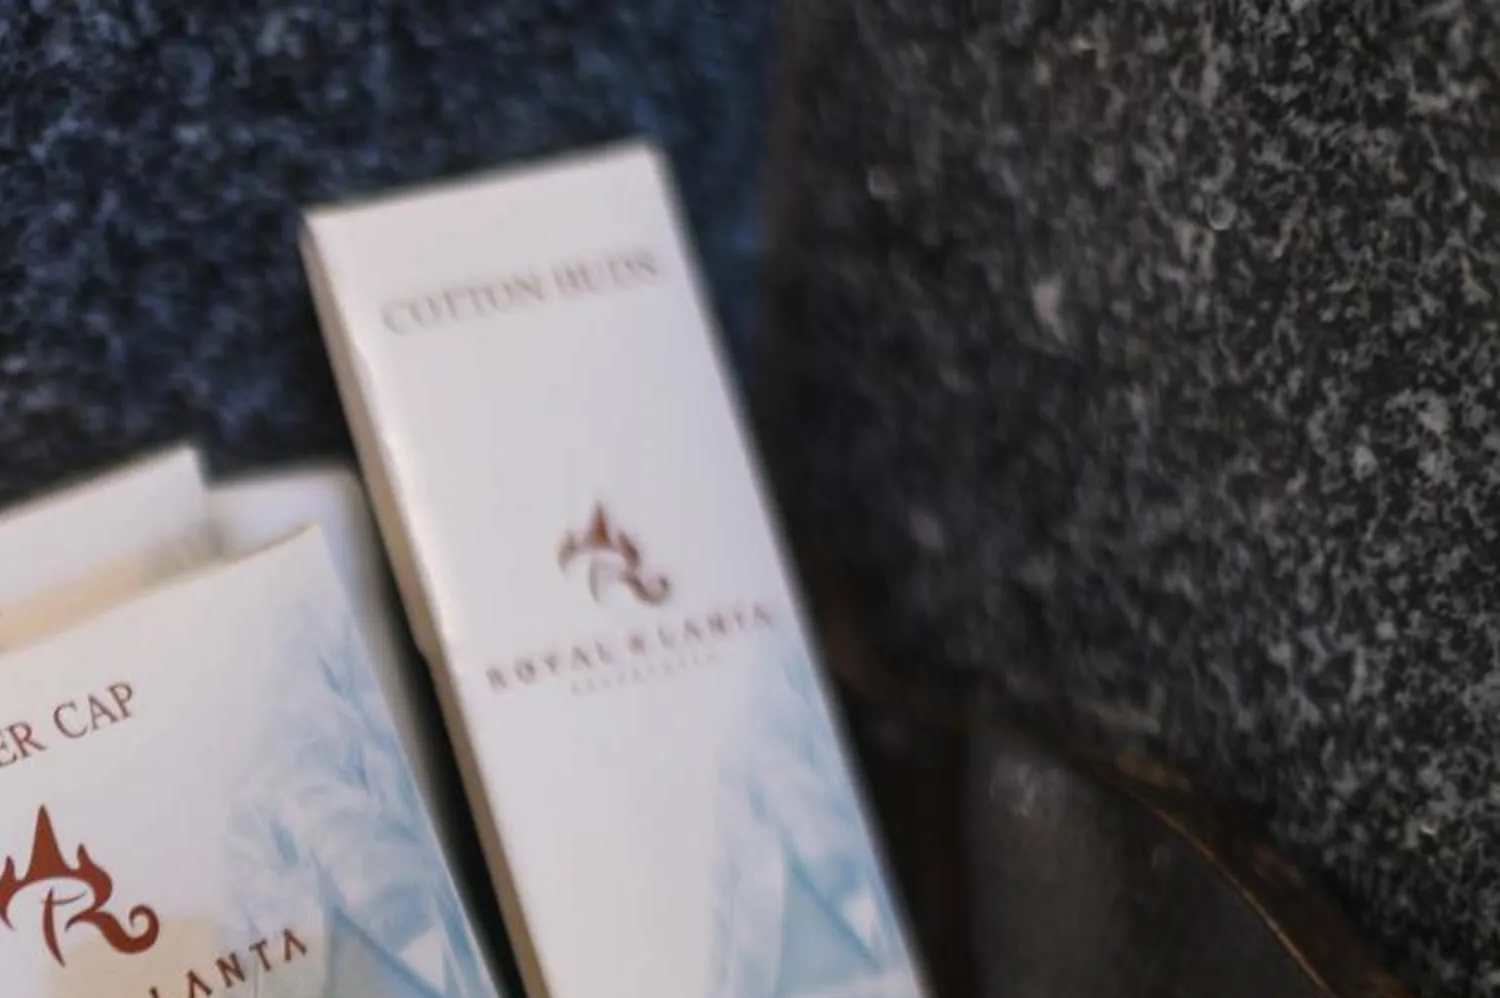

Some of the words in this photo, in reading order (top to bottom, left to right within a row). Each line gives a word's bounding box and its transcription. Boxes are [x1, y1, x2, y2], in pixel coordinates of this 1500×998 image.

[379, 272, 546, 334] COTTON
[550, 246, 659, 301] BUDS
[485, 638, 614, 692] ROYAL
[656, 603, 773, 648] LANTA
[52, 682, 136, 740] CAP
